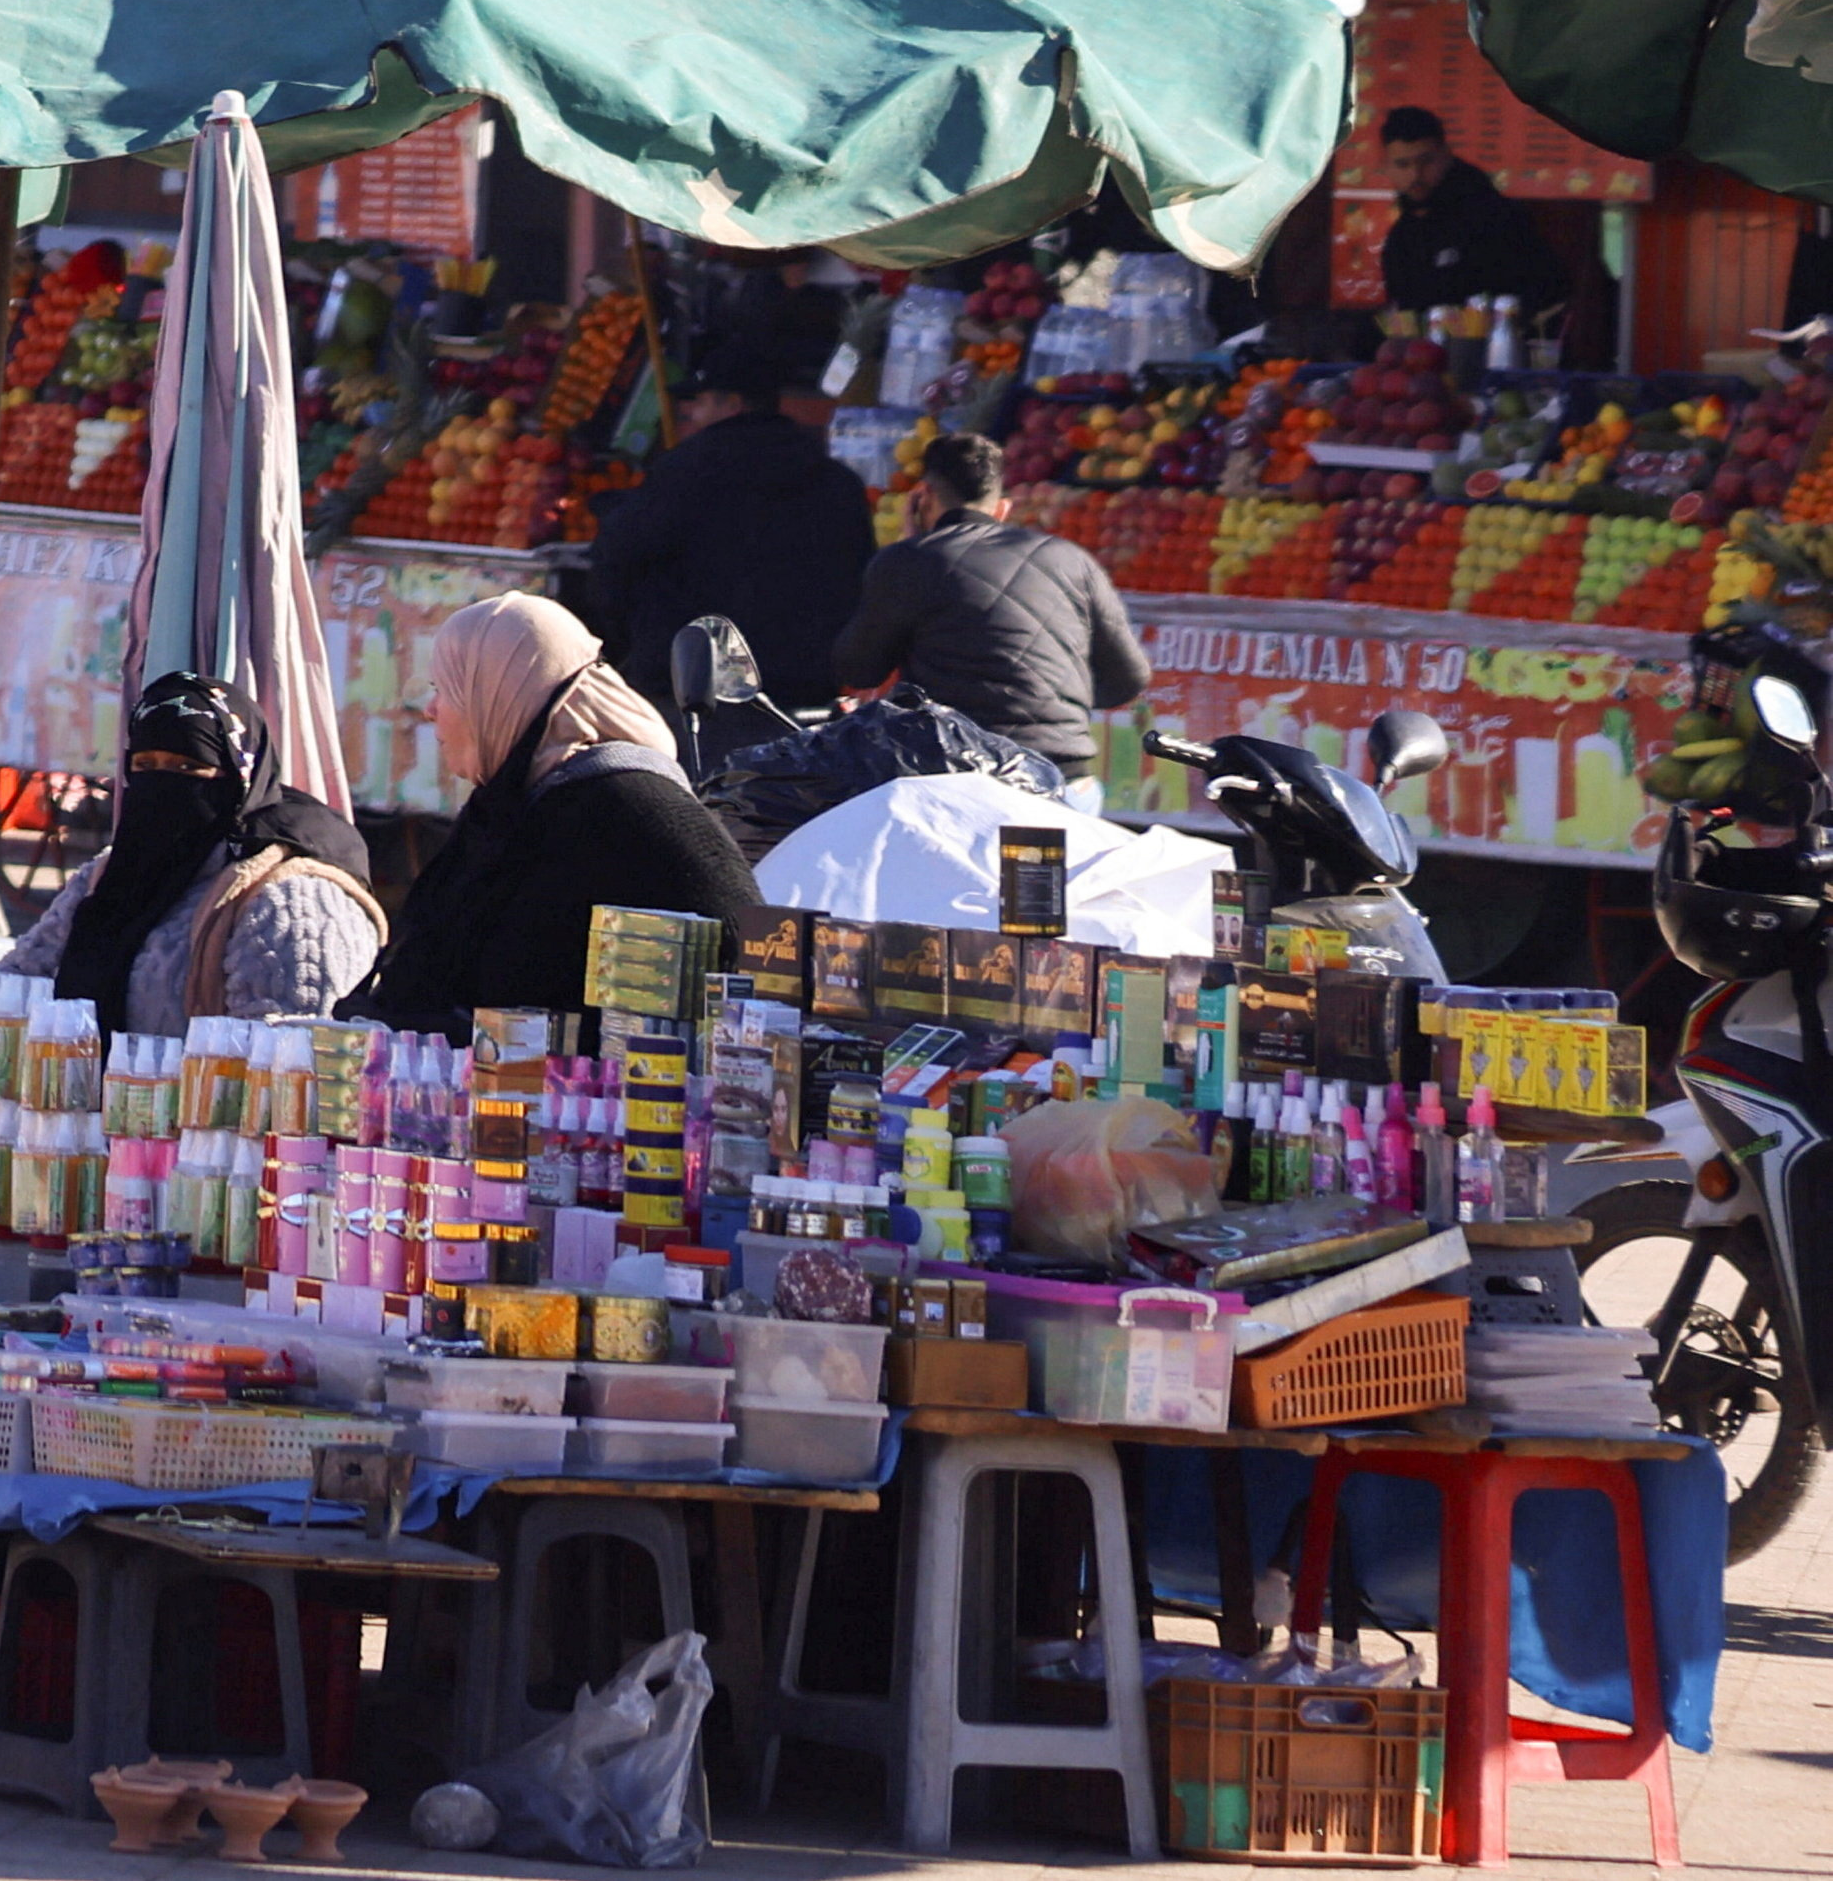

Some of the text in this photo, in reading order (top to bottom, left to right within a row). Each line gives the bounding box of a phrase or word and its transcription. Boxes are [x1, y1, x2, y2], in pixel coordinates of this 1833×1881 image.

[331, 562, 388, 608] 52
[1153, 624, 1467, 695] BOUJEMAA N 50
